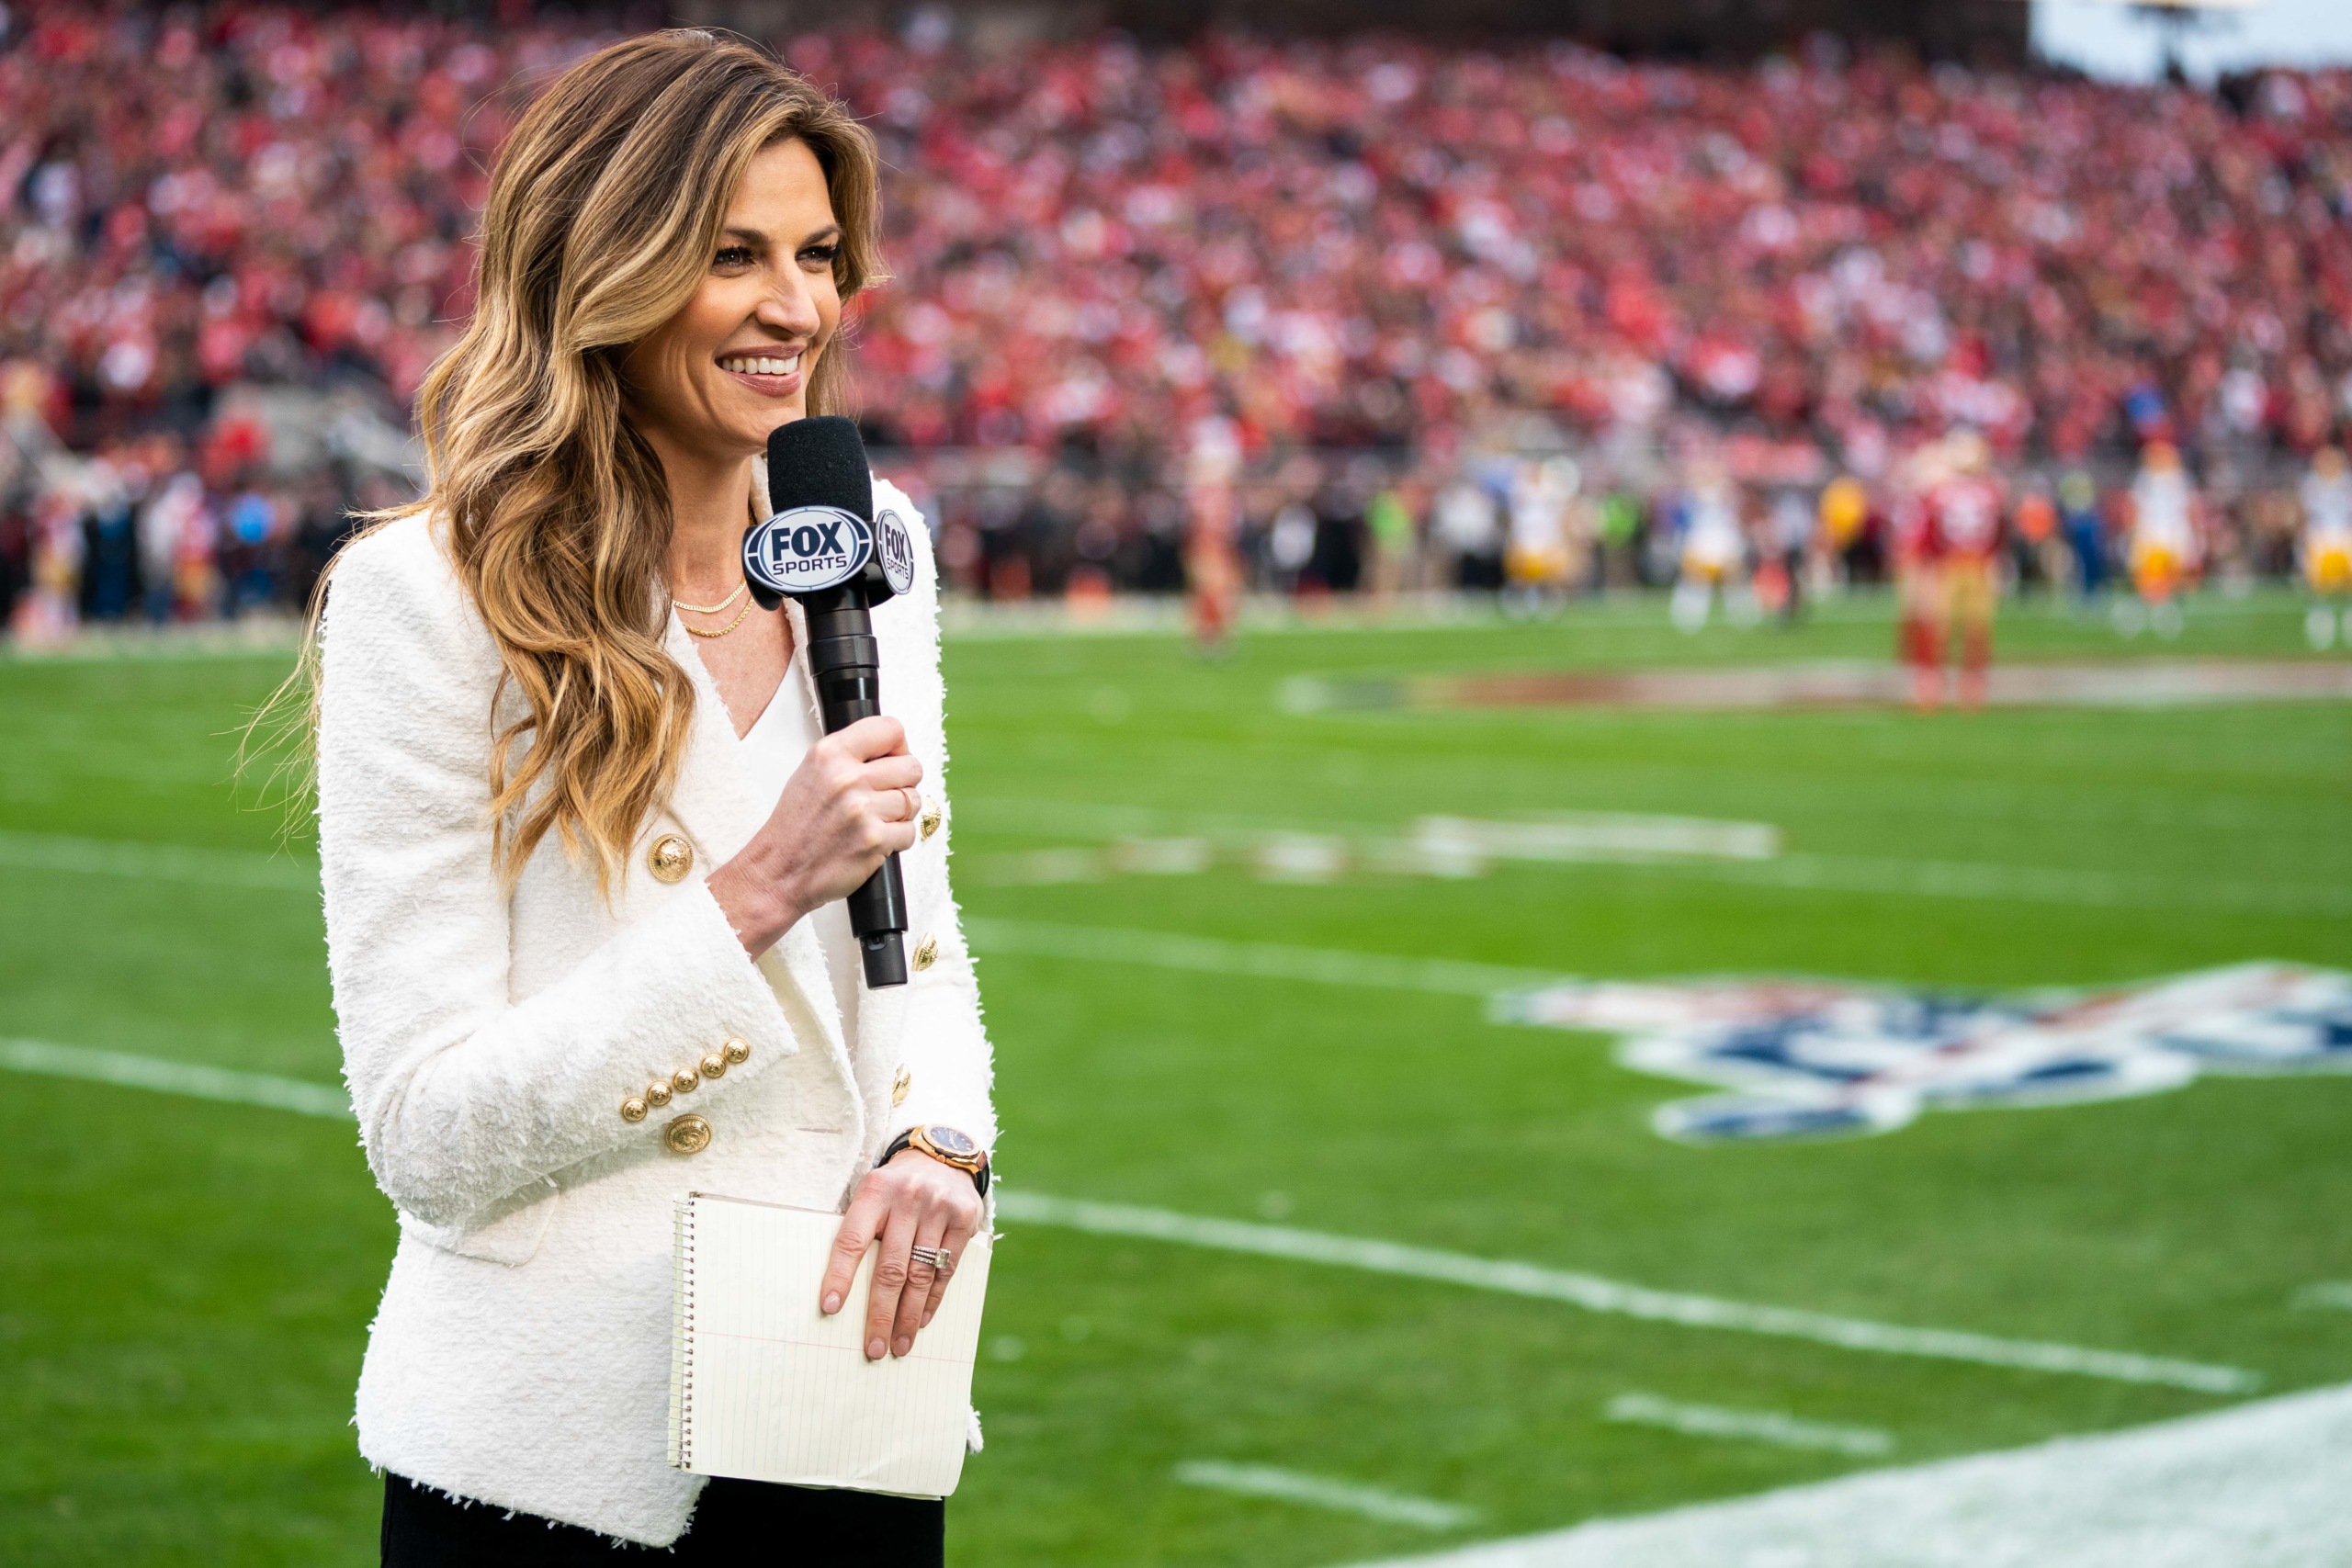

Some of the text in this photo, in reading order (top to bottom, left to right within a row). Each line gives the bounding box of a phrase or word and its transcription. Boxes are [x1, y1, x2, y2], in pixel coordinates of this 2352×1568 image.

[771, 521, 845, 561] FOX
[885, 523, 907, 566] FOX
[773, 555, 847, 576] SPORTS
[886, 558, 909, 580] SPORTS
